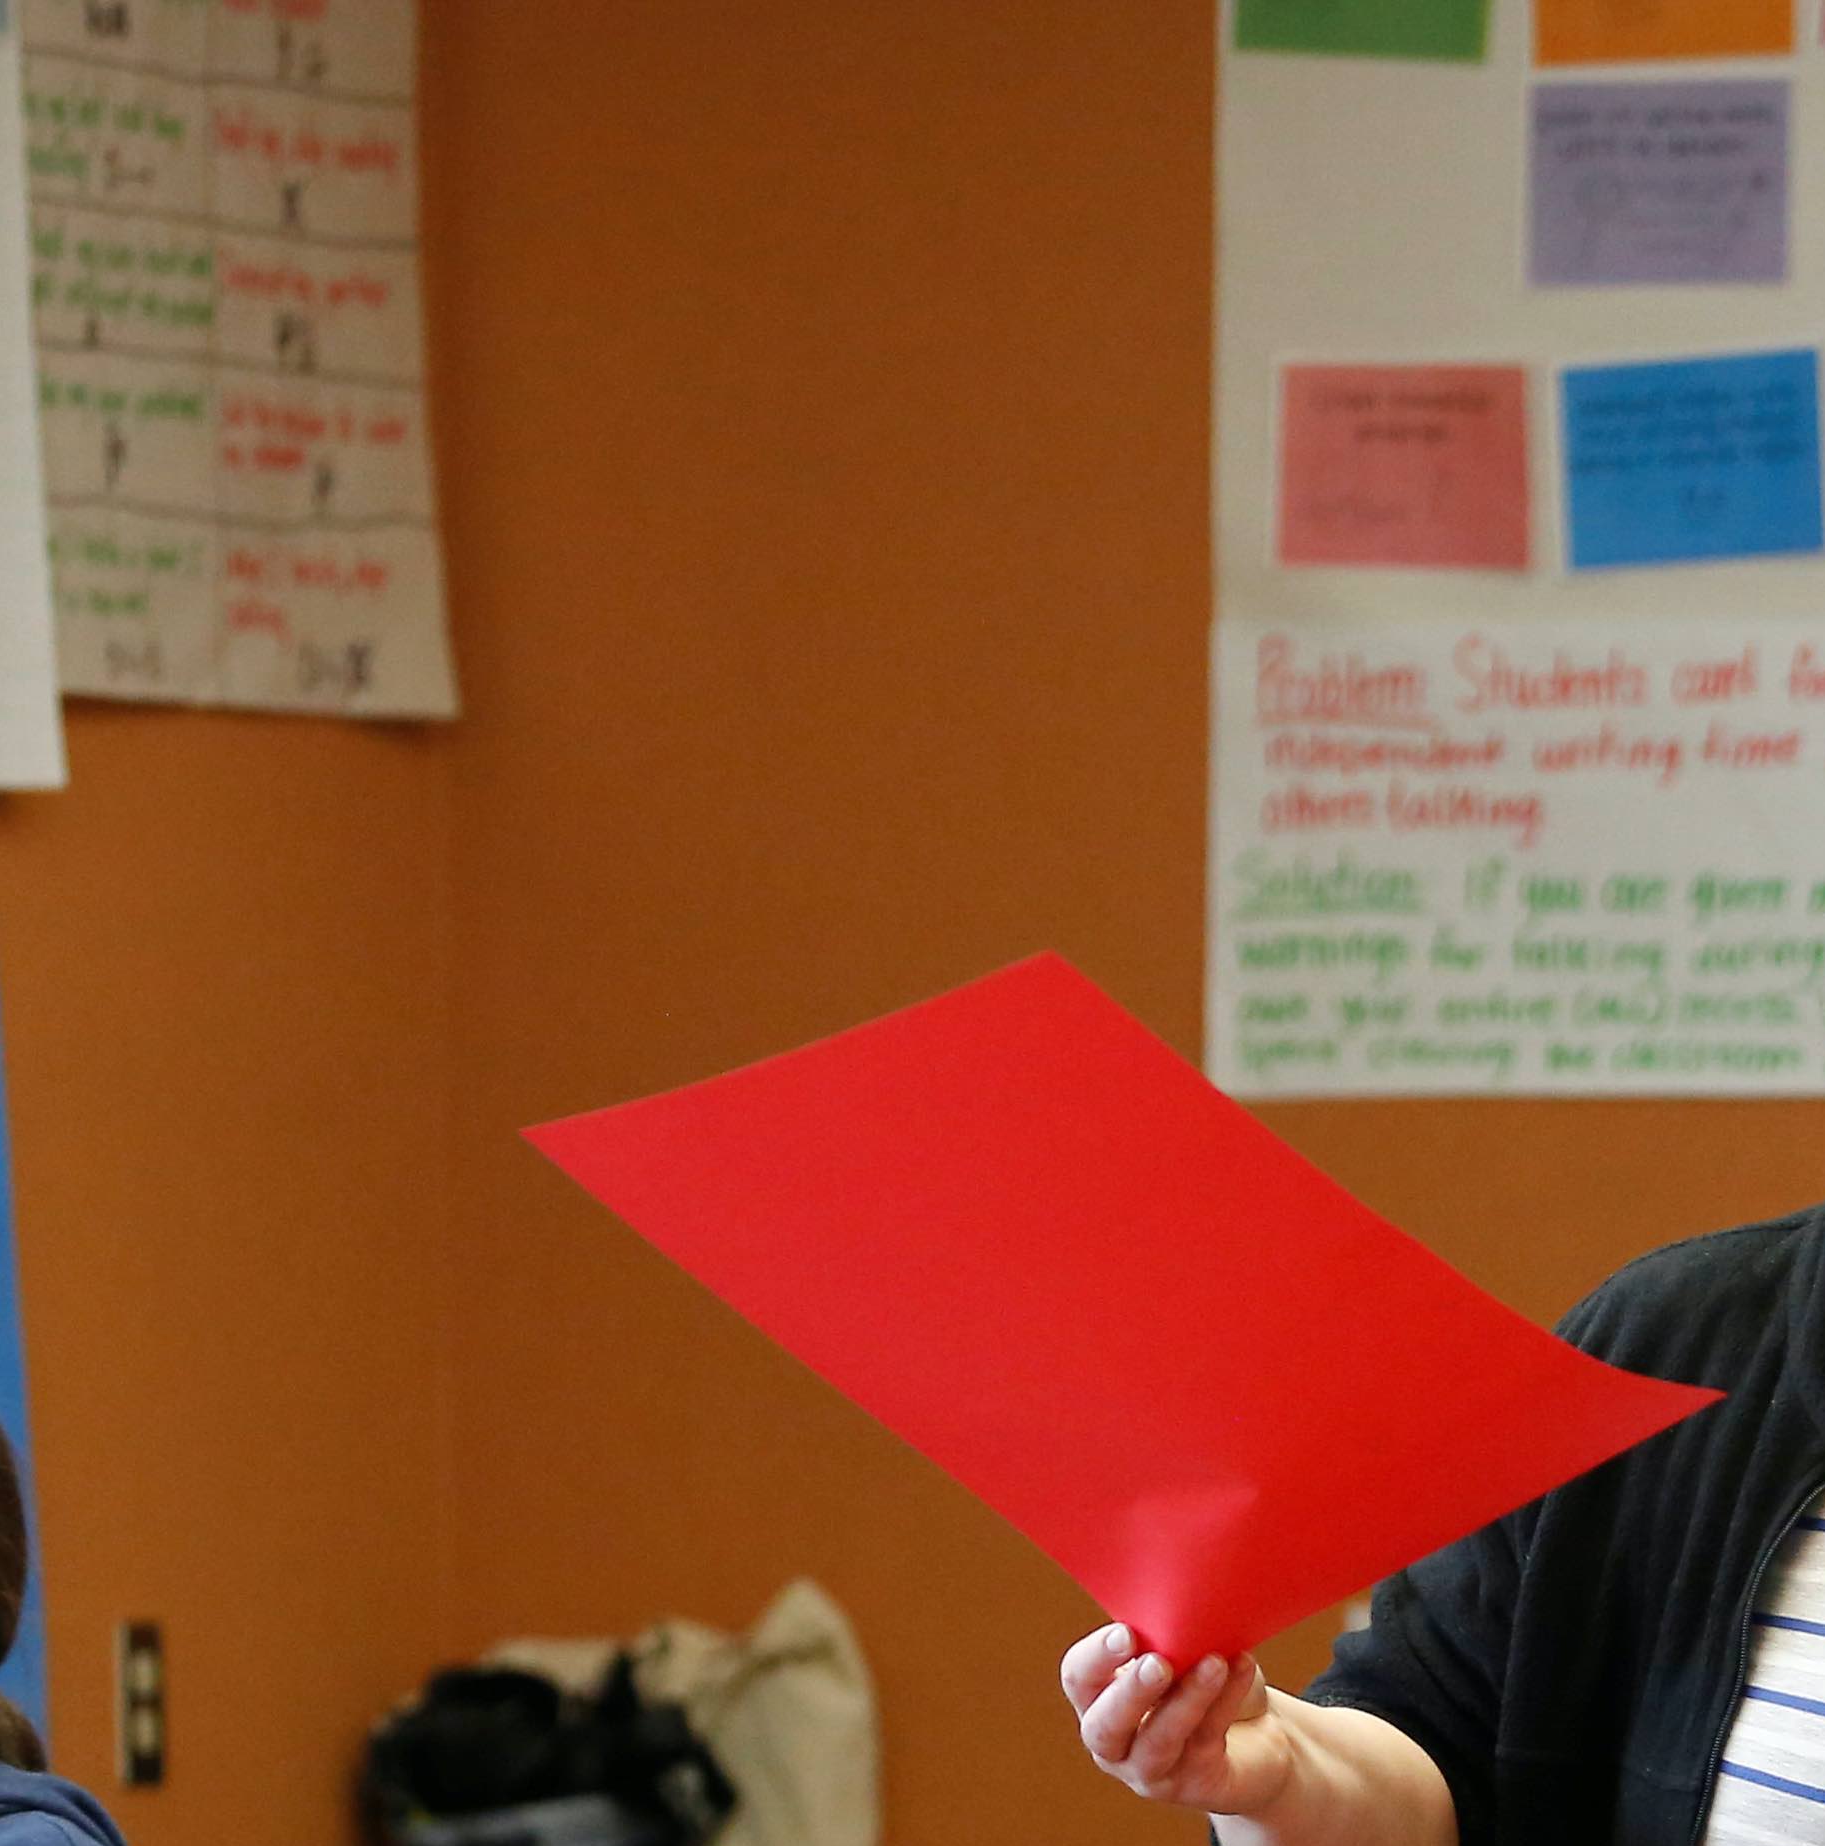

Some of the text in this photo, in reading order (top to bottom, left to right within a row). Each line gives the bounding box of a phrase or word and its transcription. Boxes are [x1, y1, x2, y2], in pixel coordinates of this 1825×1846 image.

[1453, 631, 1650, 714] Students
[1533, 721, 1682, 788] writing
[1703, 719, 1801, 769] time
